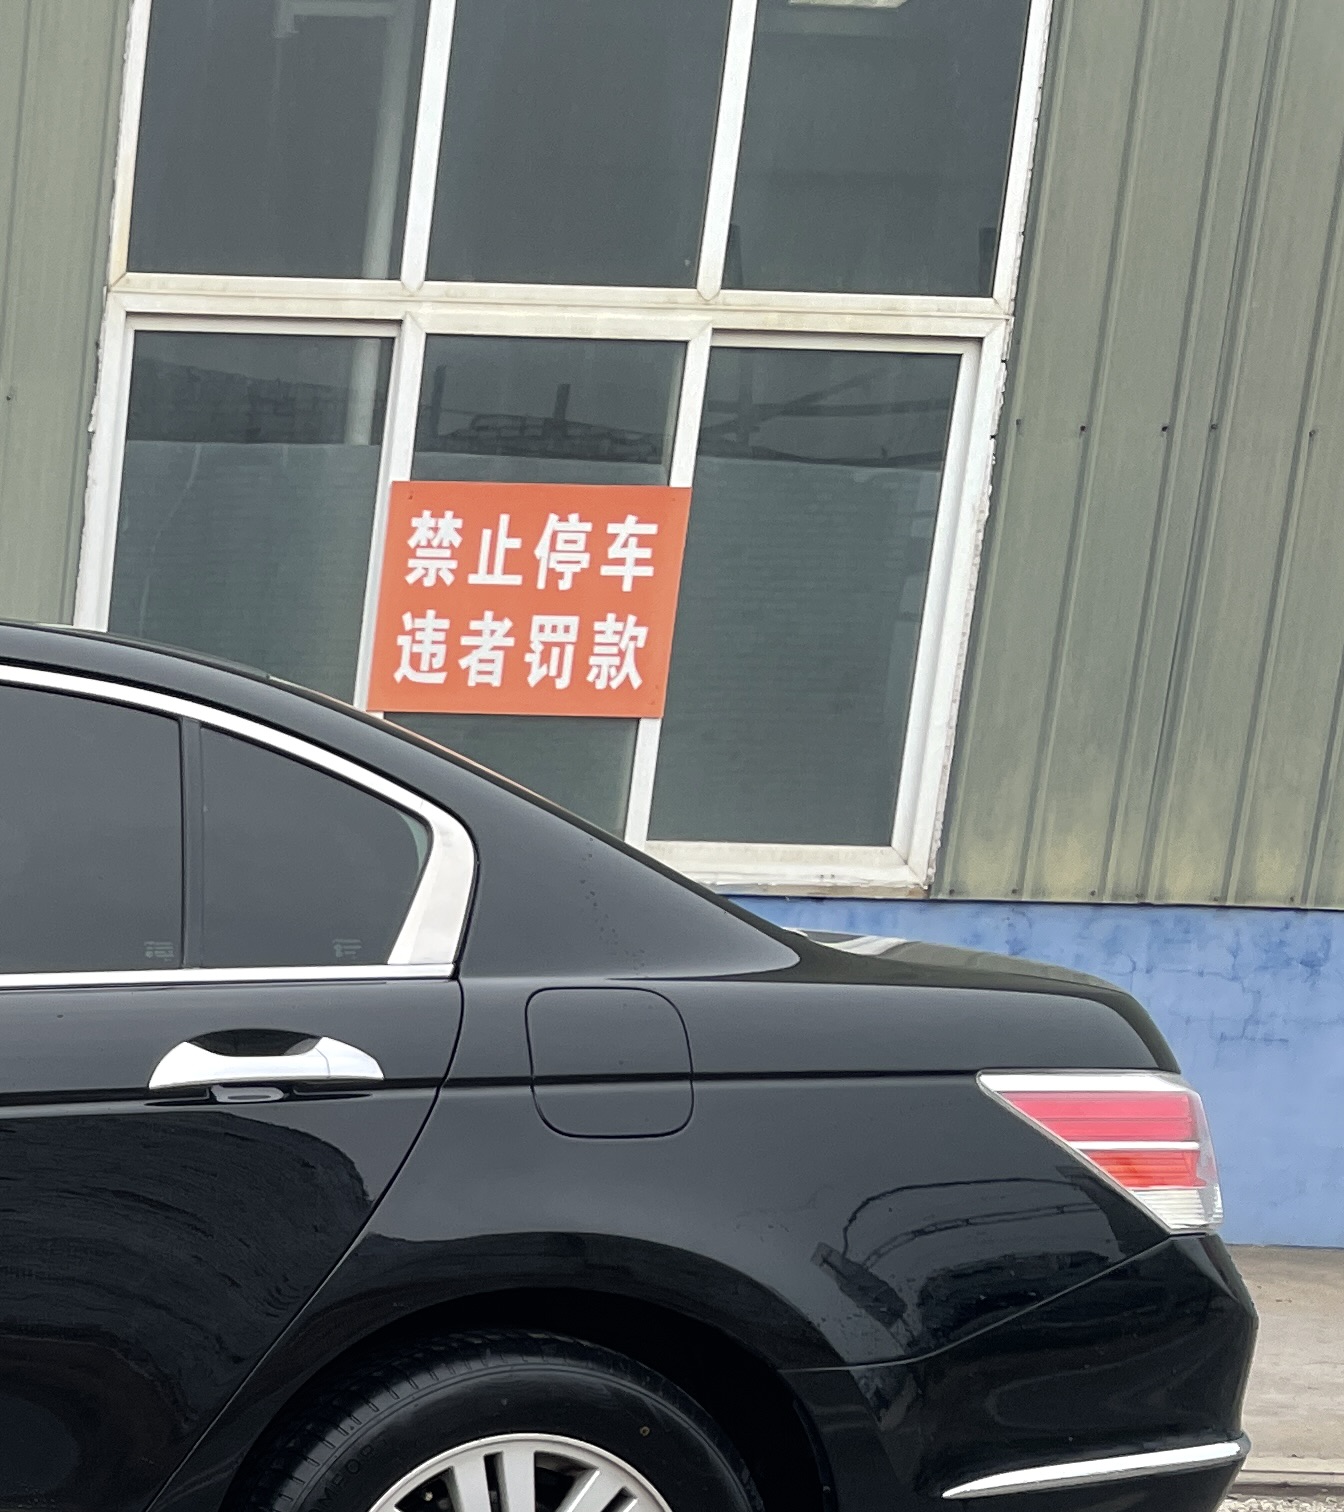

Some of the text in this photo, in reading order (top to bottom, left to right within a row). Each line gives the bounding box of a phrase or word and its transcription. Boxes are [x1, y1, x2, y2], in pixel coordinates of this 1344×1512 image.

[404, 509, 659, 592] 禁止停车
[393, 609, 649, 690] 违者罚款
